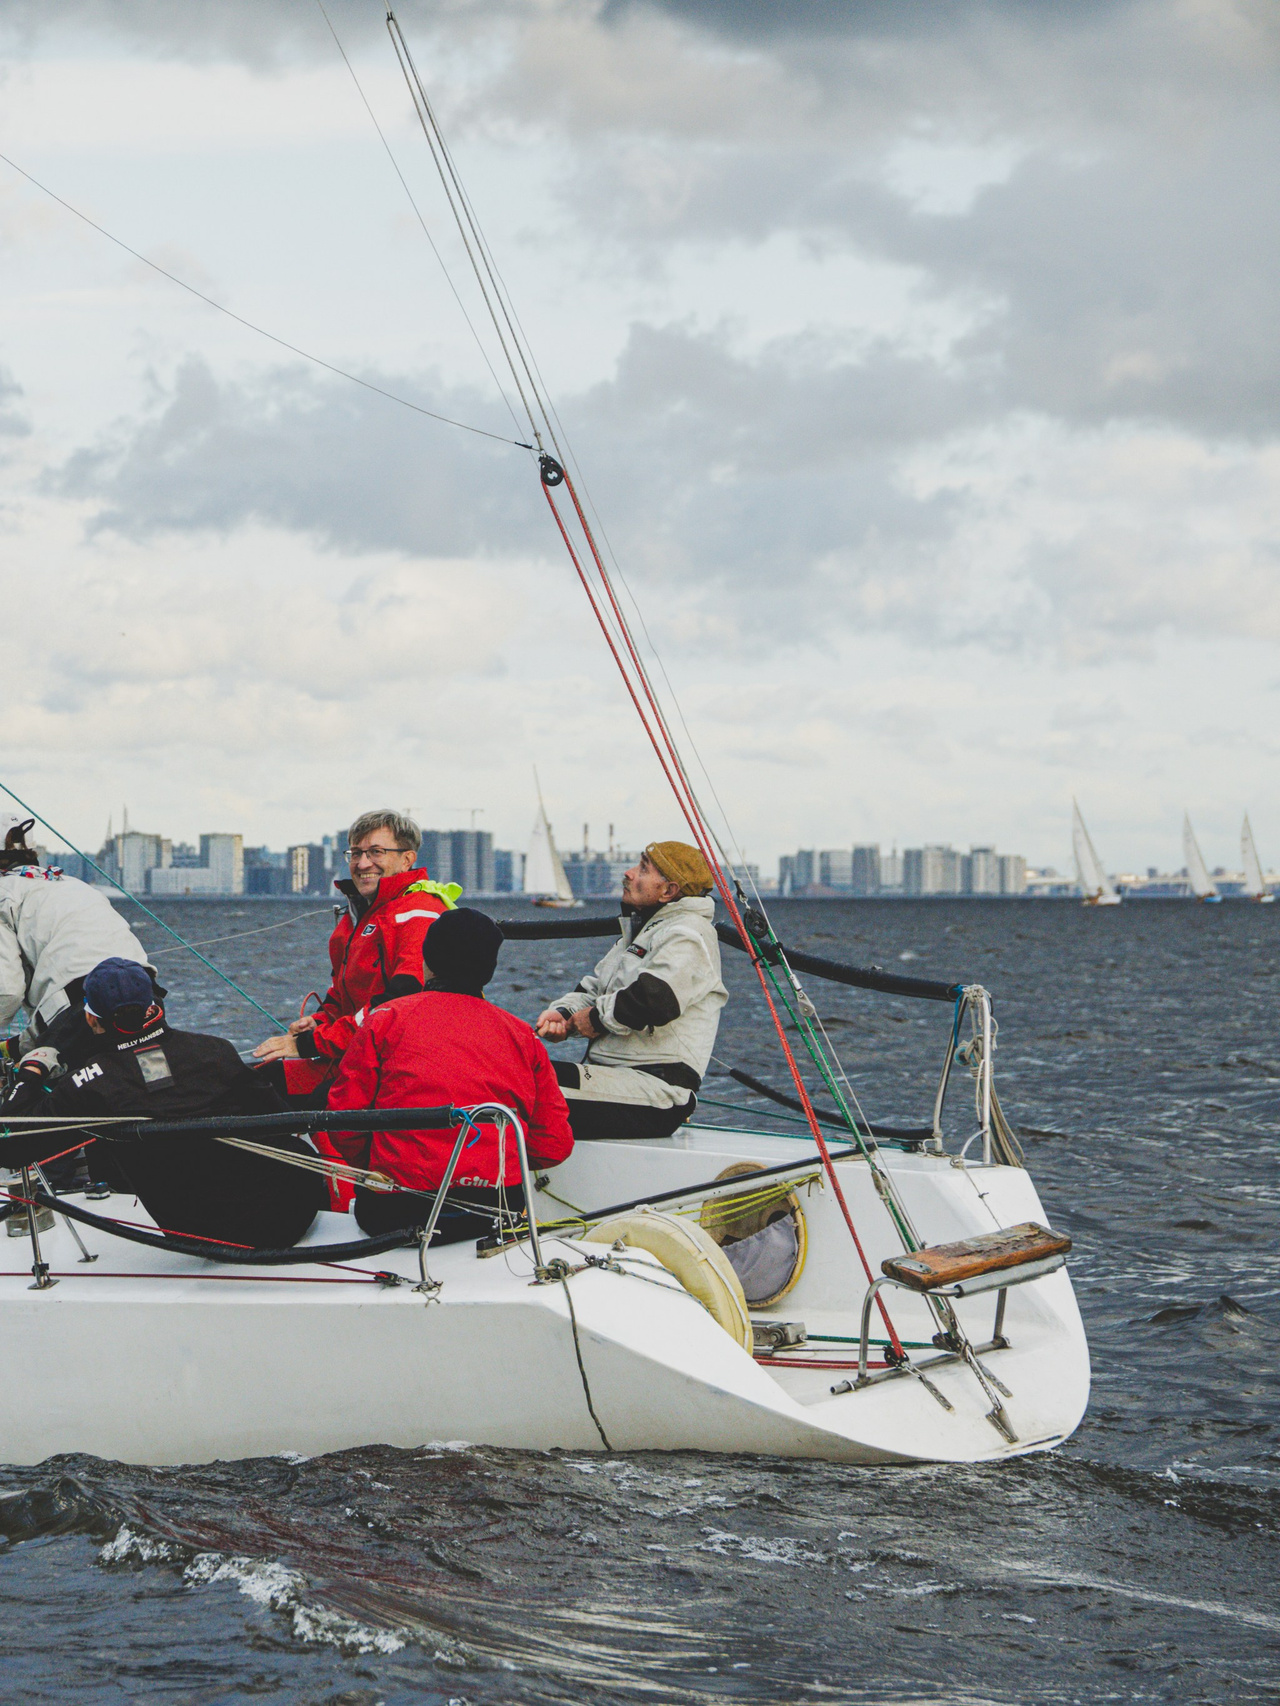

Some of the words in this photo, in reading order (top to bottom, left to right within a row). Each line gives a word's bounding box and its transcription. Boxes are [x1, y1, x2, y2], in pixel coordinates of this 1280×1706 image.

[117, 1039, 138, 1051] HELLY
[139, 1027, 164, 1044] HANSEN
[72, 1062, 104, 1088] HH
[460, 1176, 489, 1187] Gill
